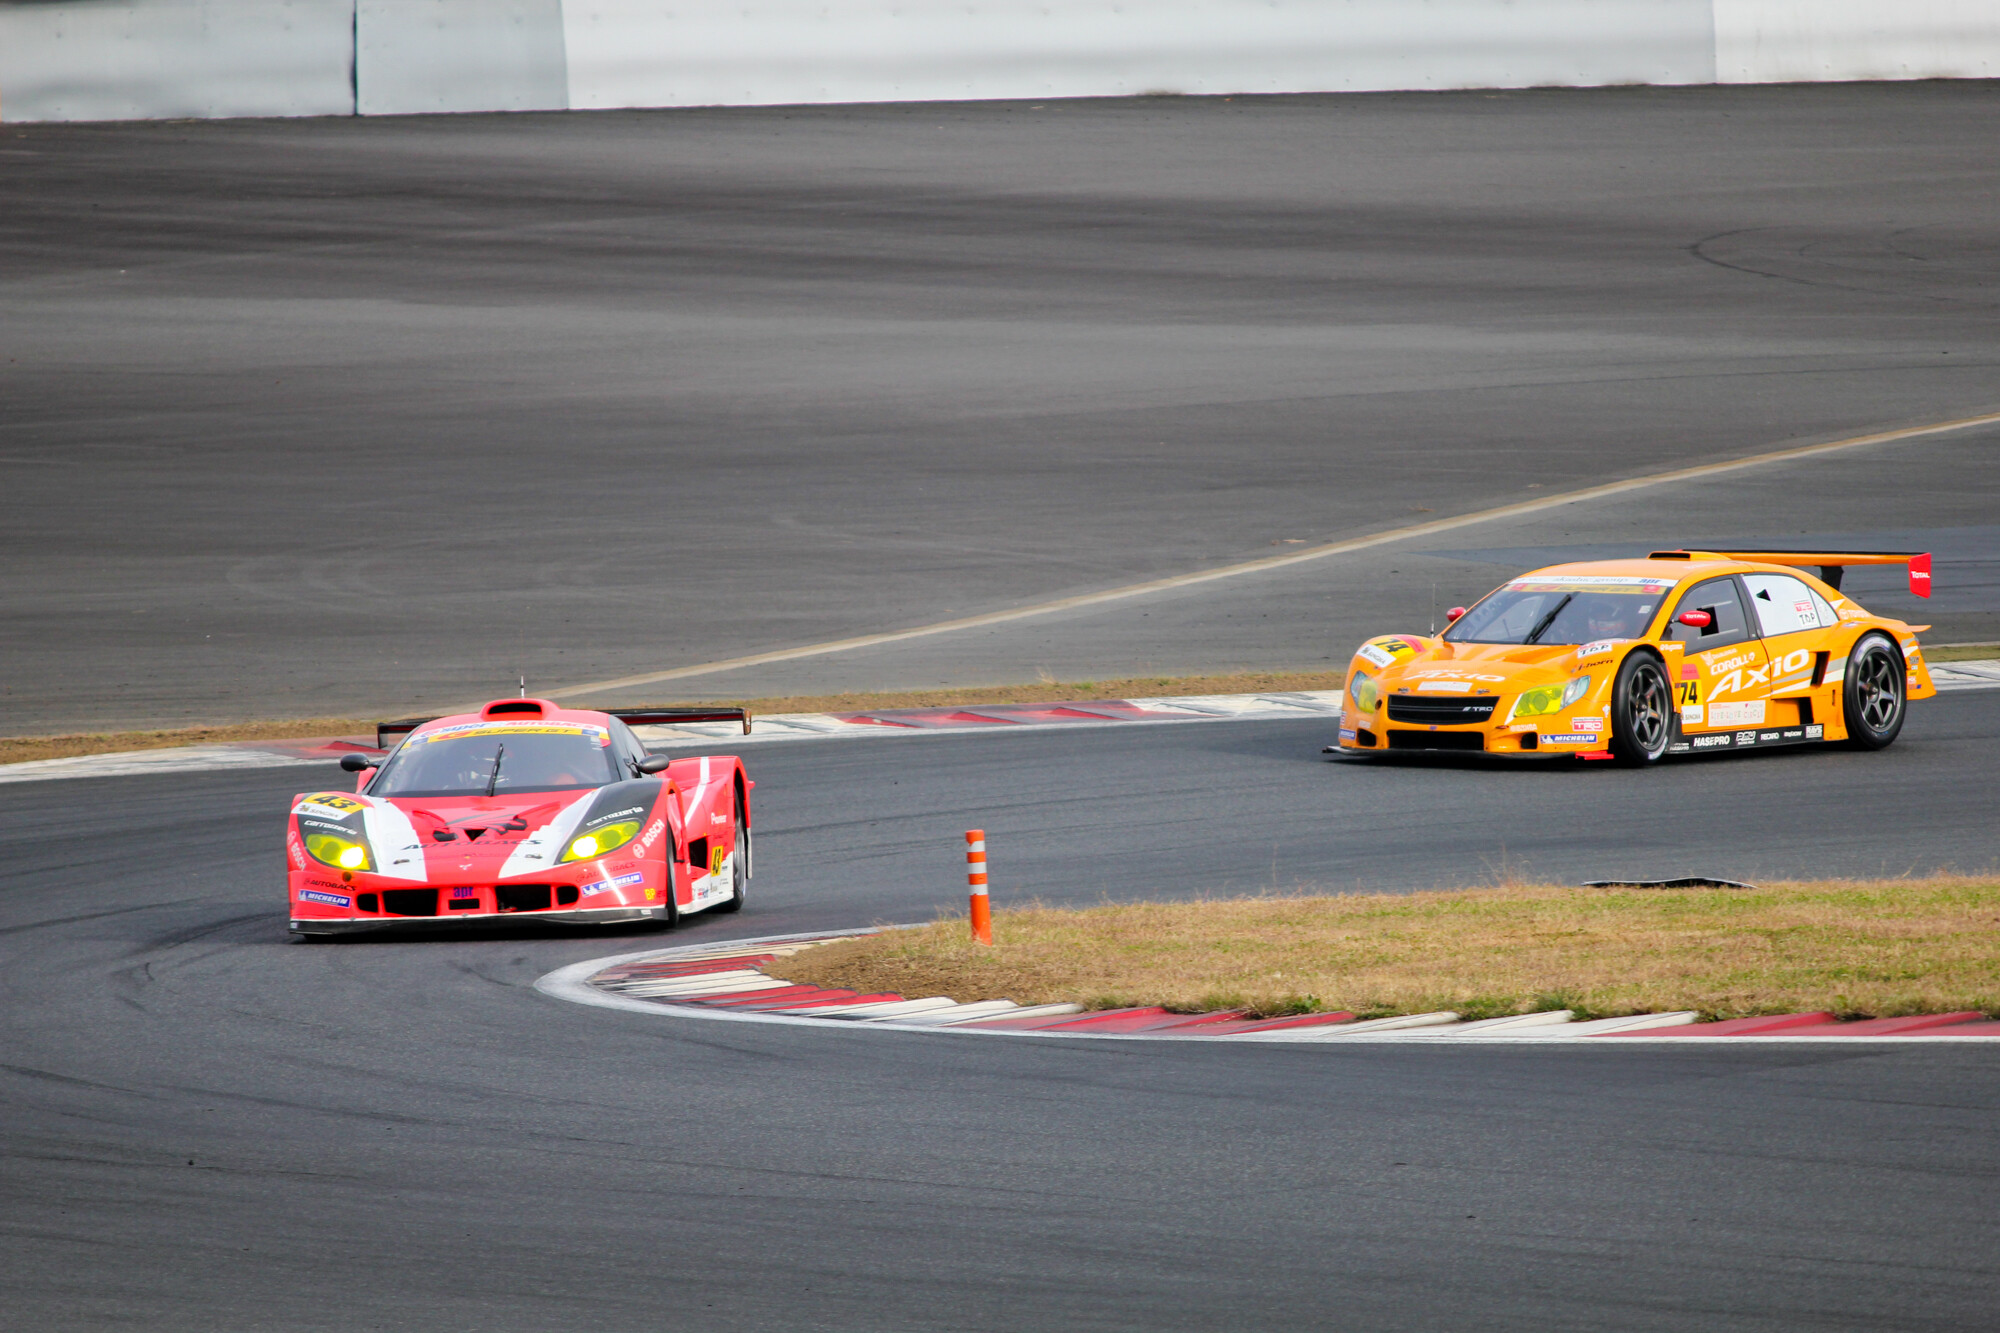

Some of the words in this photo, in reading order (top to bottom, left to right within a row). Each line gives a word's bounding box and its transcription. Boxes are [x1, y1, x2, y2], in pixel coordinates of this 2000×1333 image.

[1680, 681, 1698, 705] 74
[1554, 732, 1595, 742] MICHELIN
[1694, 735, 1730, 747] HASEPRO
[313, 795, 357, 809] 43
[641, 818, 665, 848] BOSCH
[310, 879, 356, 891] AUTOBACS
[453, 886, 473, 898] apr
[307, 892, 348, 905] MICHELIN
